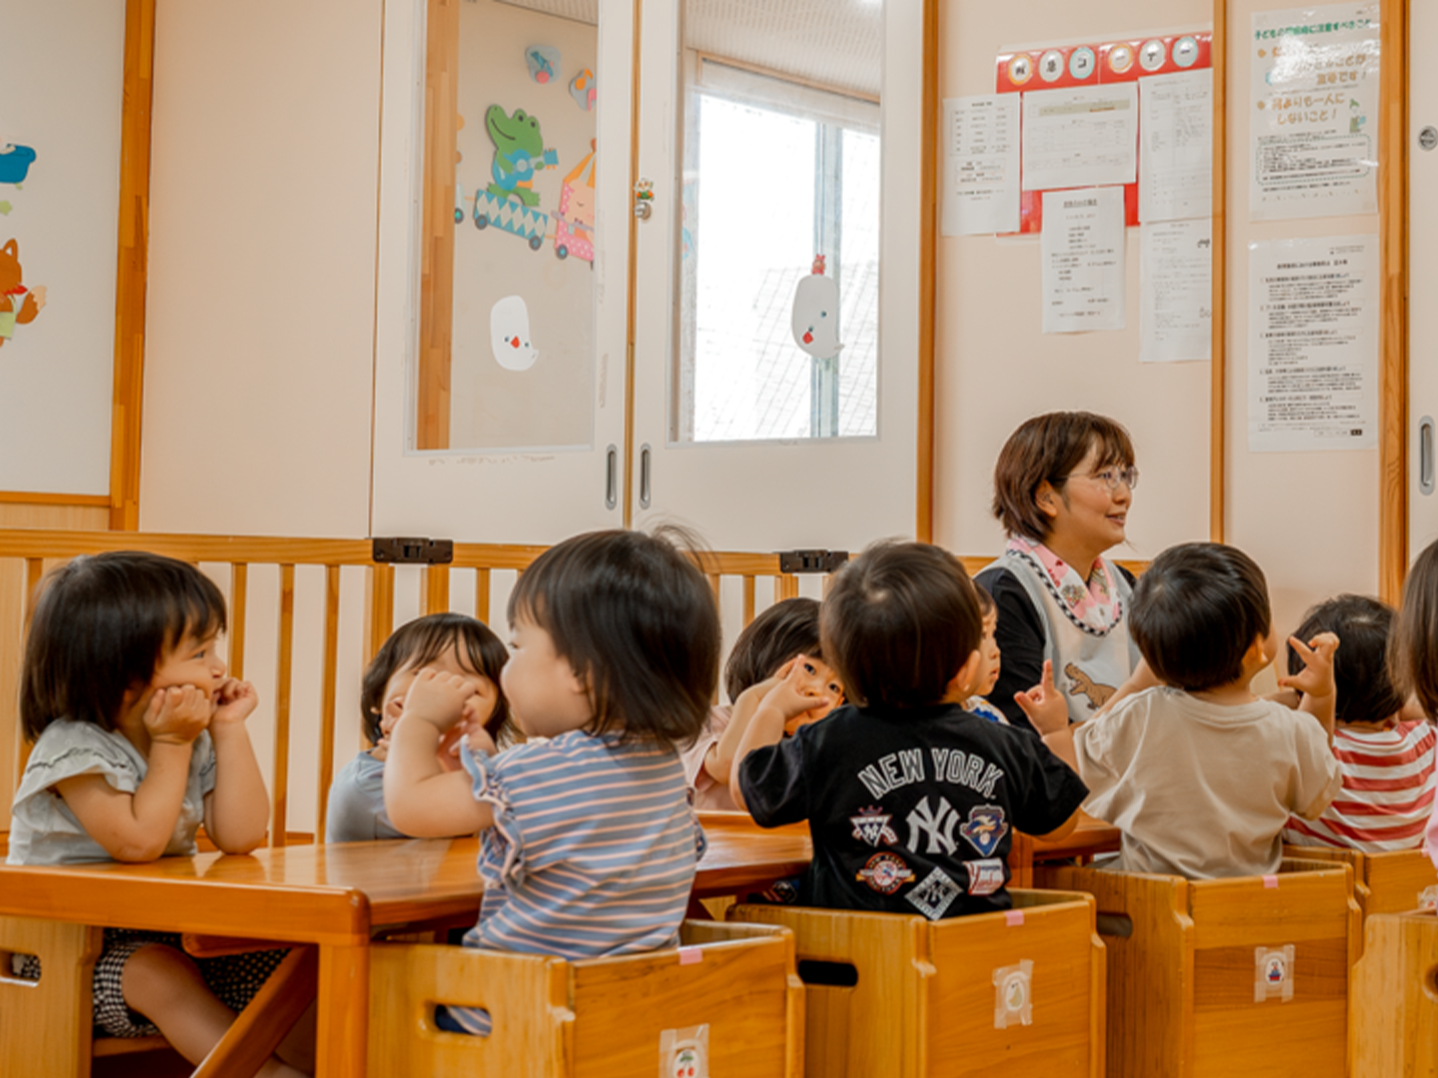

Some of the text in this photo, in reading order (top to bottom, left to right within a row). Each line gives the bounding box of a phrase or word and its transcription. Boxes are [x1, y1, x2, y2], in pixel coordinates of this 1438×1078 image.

[857, 748, 1004, 800] NEW YORK
[906, 795, 960, 856] NY
